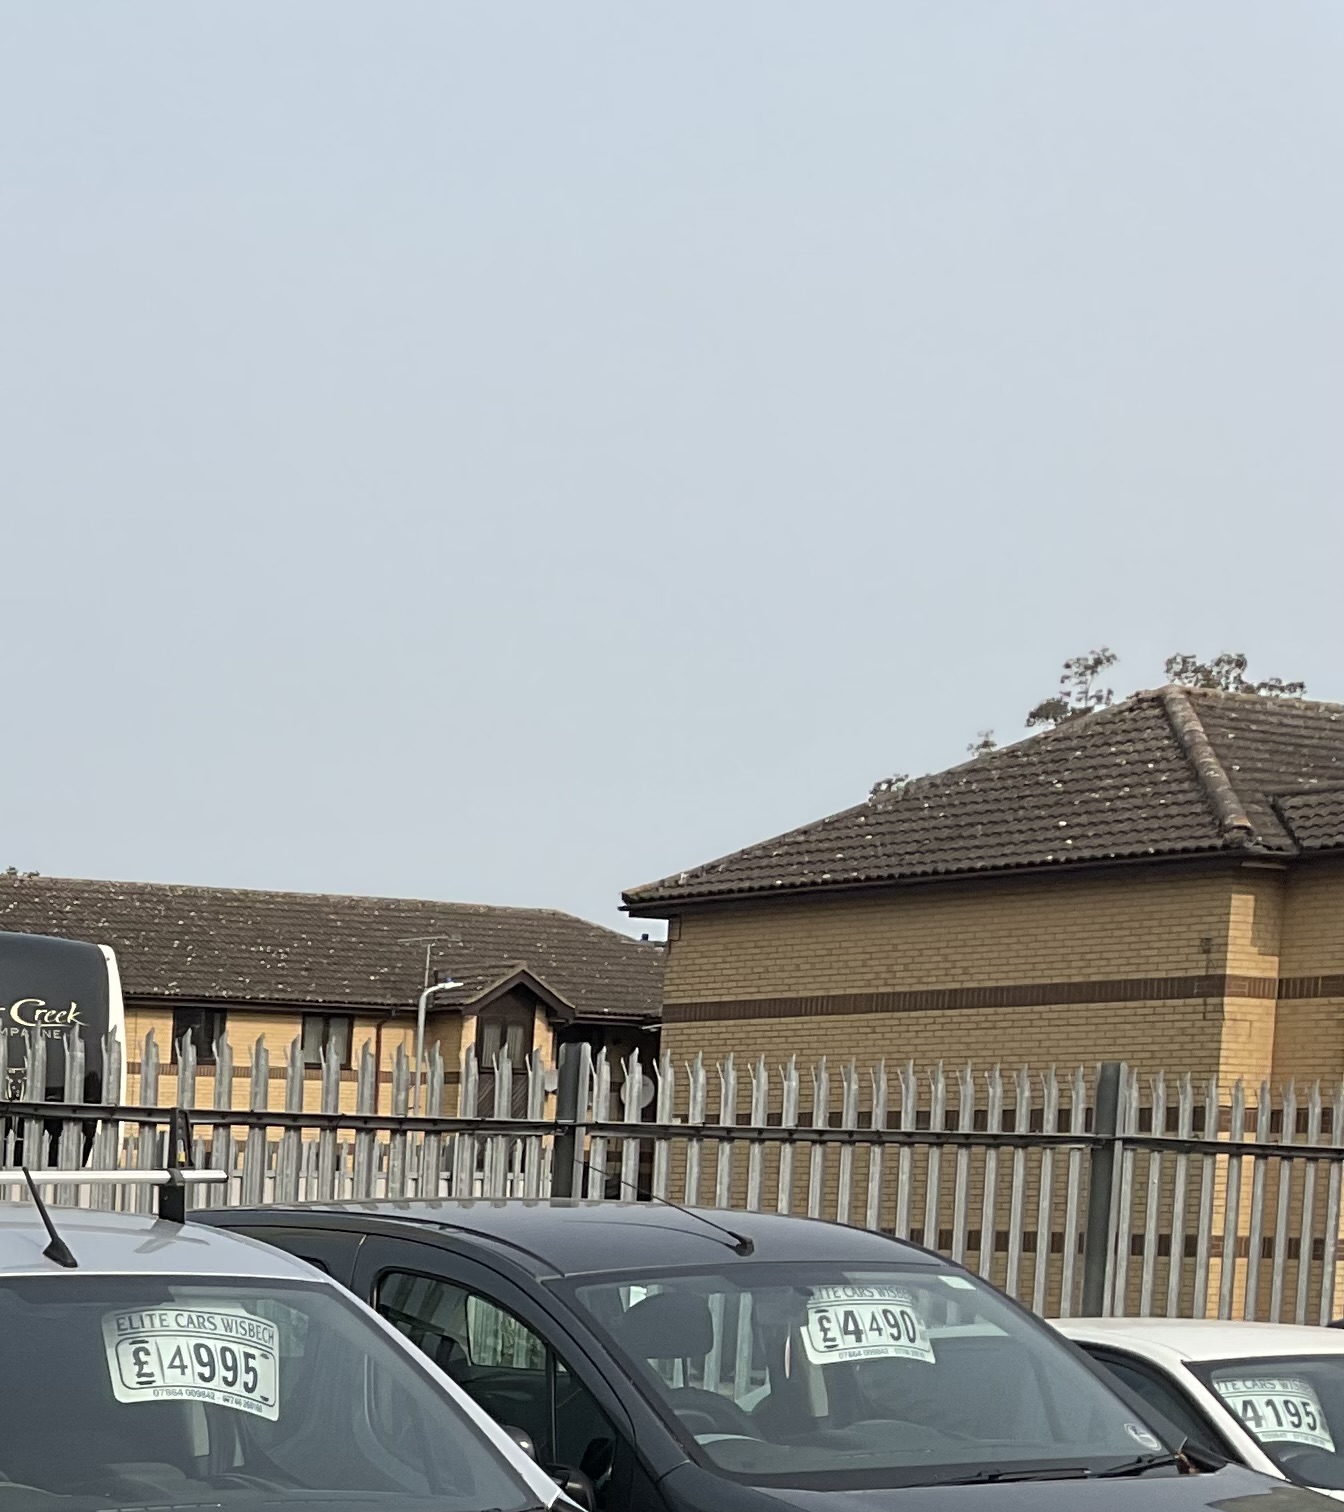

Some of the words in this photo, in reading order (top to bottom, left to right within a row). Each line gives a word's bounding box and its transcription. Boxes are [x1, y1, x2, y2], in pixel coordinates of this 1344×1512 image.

[10, 998, 90, 1027] Creek
[843, 1286, 875, 1298] CARS
[115, 1312, 170, 1332] ELITE
[174, 1312, 218, 1332] CARS
[220, 1316, 275, 1345] WISBECH
